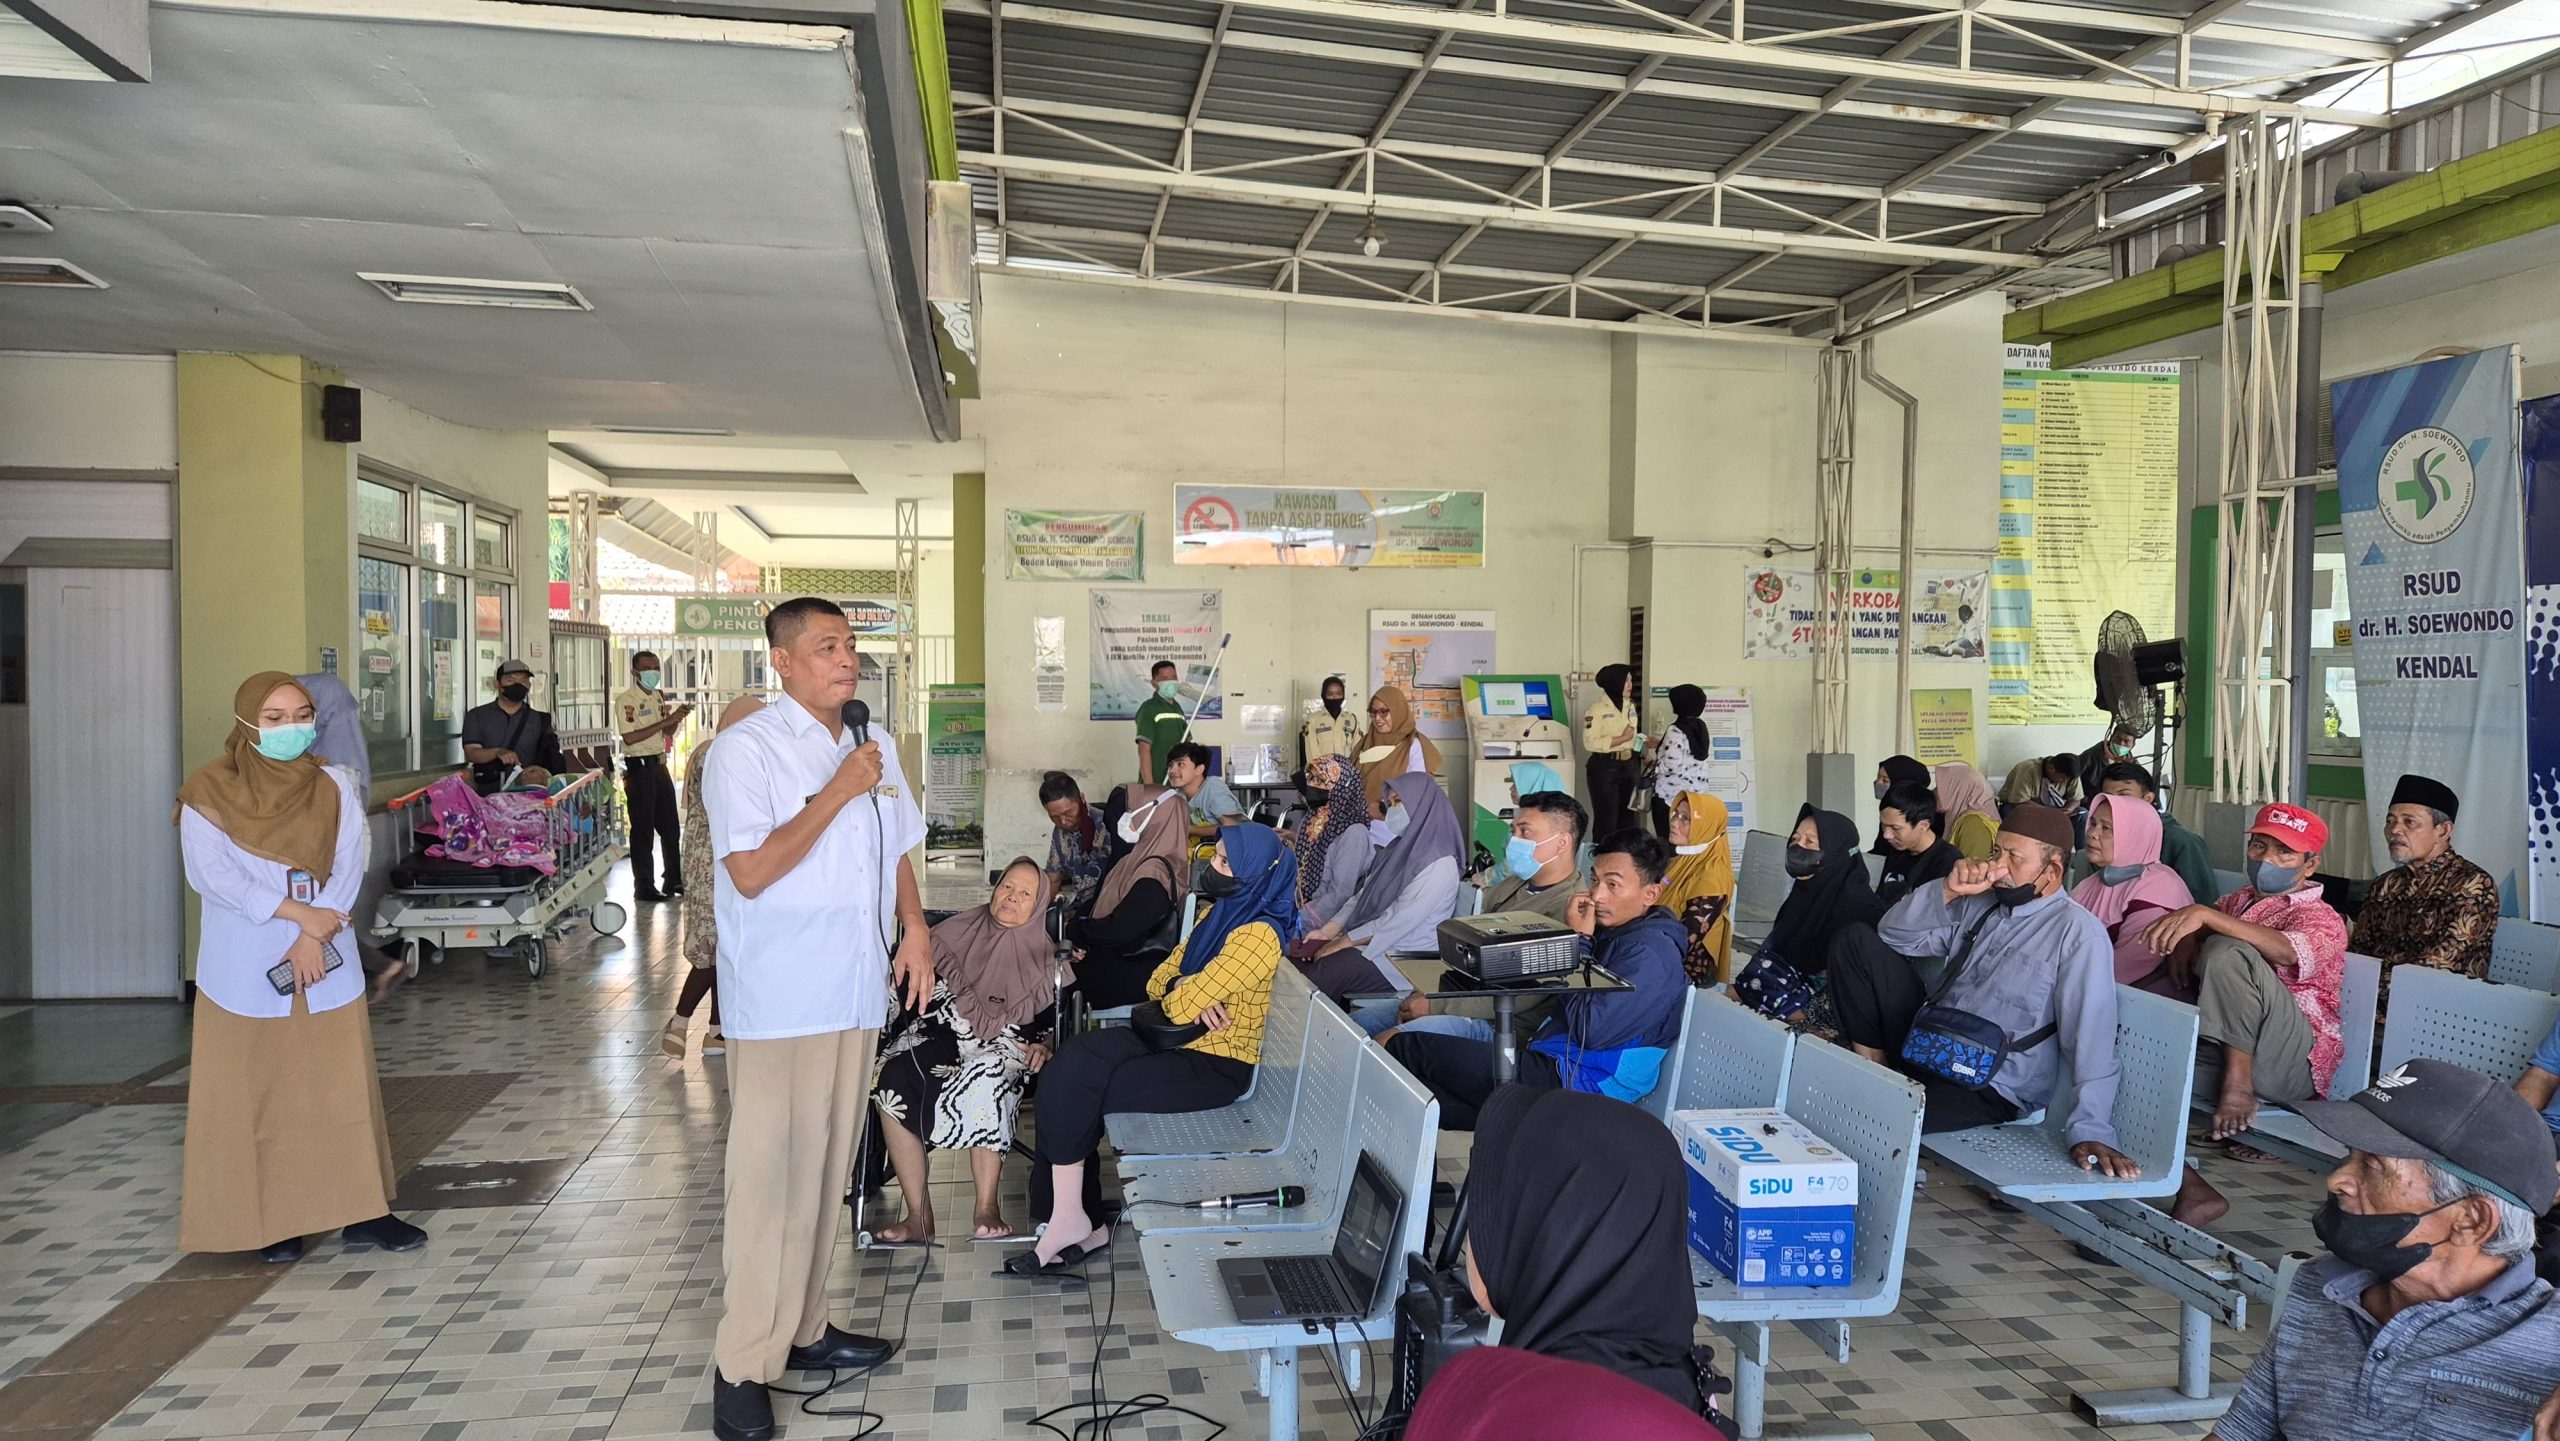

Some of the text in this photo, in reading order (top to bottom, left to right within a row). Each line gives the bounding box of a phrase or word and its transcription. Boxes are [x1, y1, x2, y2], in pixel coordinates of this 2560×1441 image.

[2007, 347, 2050, 358] DAFTAR NA
[2140, 365, 2178, 373] KENDAL
[2382, 449, 2398, 475] RSUD
[2422, 430, 2466, 463] SOEWONDO
[1274, 494, 1337, 511] KAWASAN
[1245, 511, 1367, 529] TANPA ASAP ROKOK
[2412, 531, 2435, 540] adalah
[1047, 558, 1078, 568] Layanan
[1080, 559, 1104, 567] Umum
[2403, 571, 2461, 597] RSUD
[548, 608, 570, 620] OKOK
[718, 605, 764, 617] PINTU
[1141, 614, 1171, 623] LOKASI
[1860, 611, 1883, 623] YANG
[713, 619, 766, 630] PENGU
[2359, 609, 2514, 637] dr. H. SOEWONDO
[2396, 655, 2478, 679] KENDAL
[1705, 1126, 1782, 1163] SiDU
[1687, 1137, 1707, 1166] SiDU
[1718, 1161, 1727, 1176] F4
[1749, 1175, 1849, 1195] SiDU F4 70
[1724, 1215, 1733, 1232] F4
